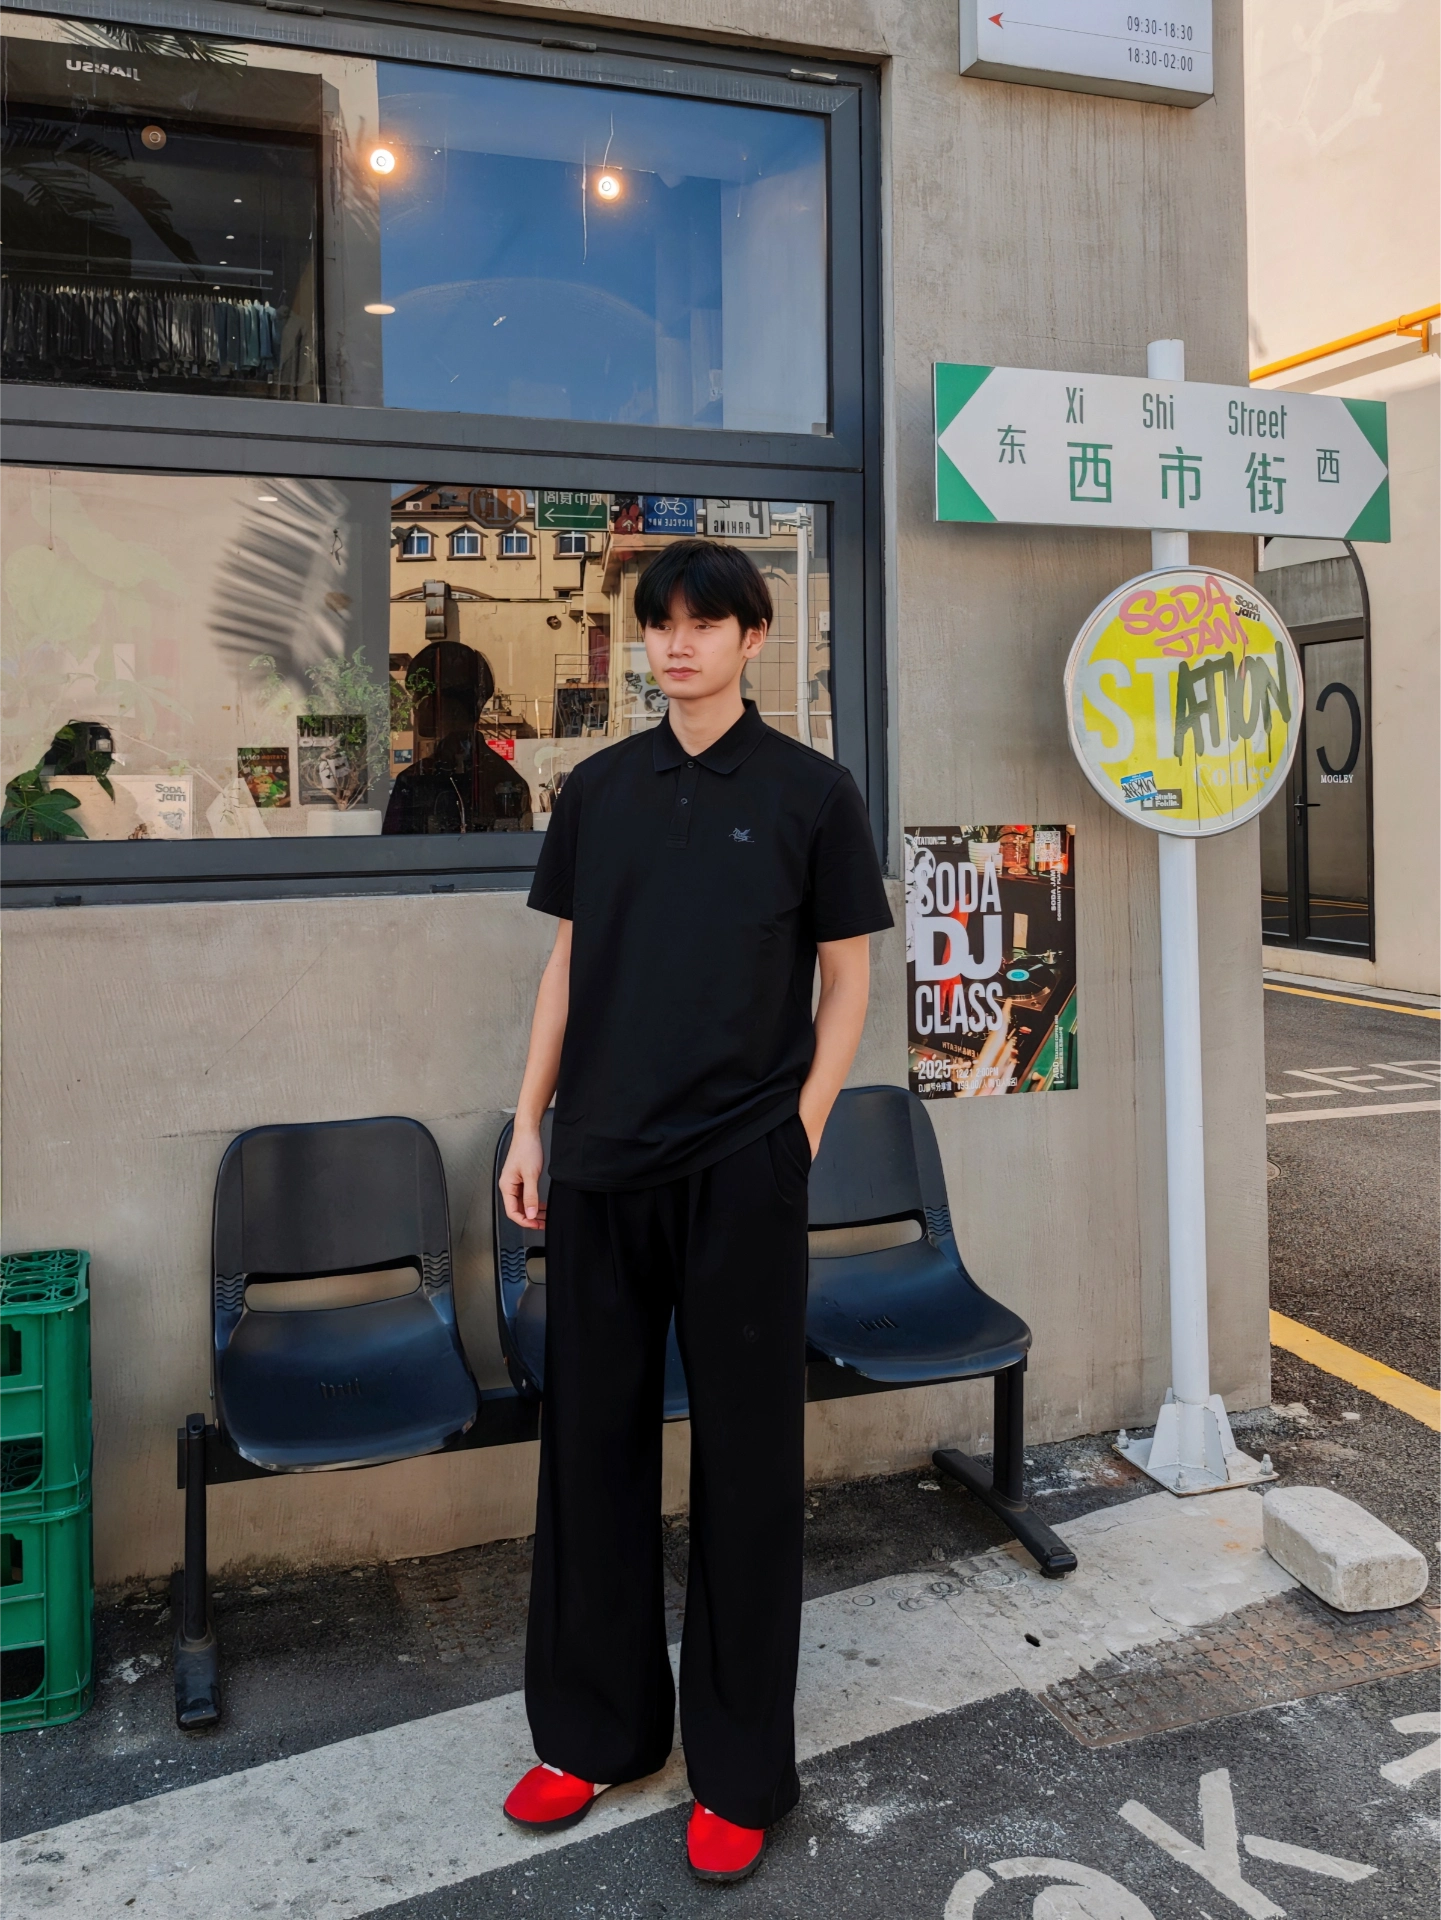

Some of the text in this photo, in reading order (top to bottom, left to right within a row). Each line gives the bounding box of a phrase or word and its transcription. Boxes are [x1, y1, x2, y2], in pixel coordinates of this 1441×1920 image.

[1127, 15, 1193, 41] 09:30-18:30
[1128, 47, 1193, 72] 18:30-02:00
[1065, 386, 1288, 439] Xi Shi Street
[997, 424, 1027, 464] 东
[1316, 448, 1341, 483] 西
[1067, 441, 1288, 514] 西市街
[1119, 575, 1233, 635] SODA
[1154, 611, 1249, 658] JAM
[1320, 774, 1354, 784] MOGLEY
[914, 859, 1002, 915] SODA
[914, 914, 1003, 982] DJ
[915, 981, 1003, 1035] CLASS
[917, 1059, 951, 1080] 2025
